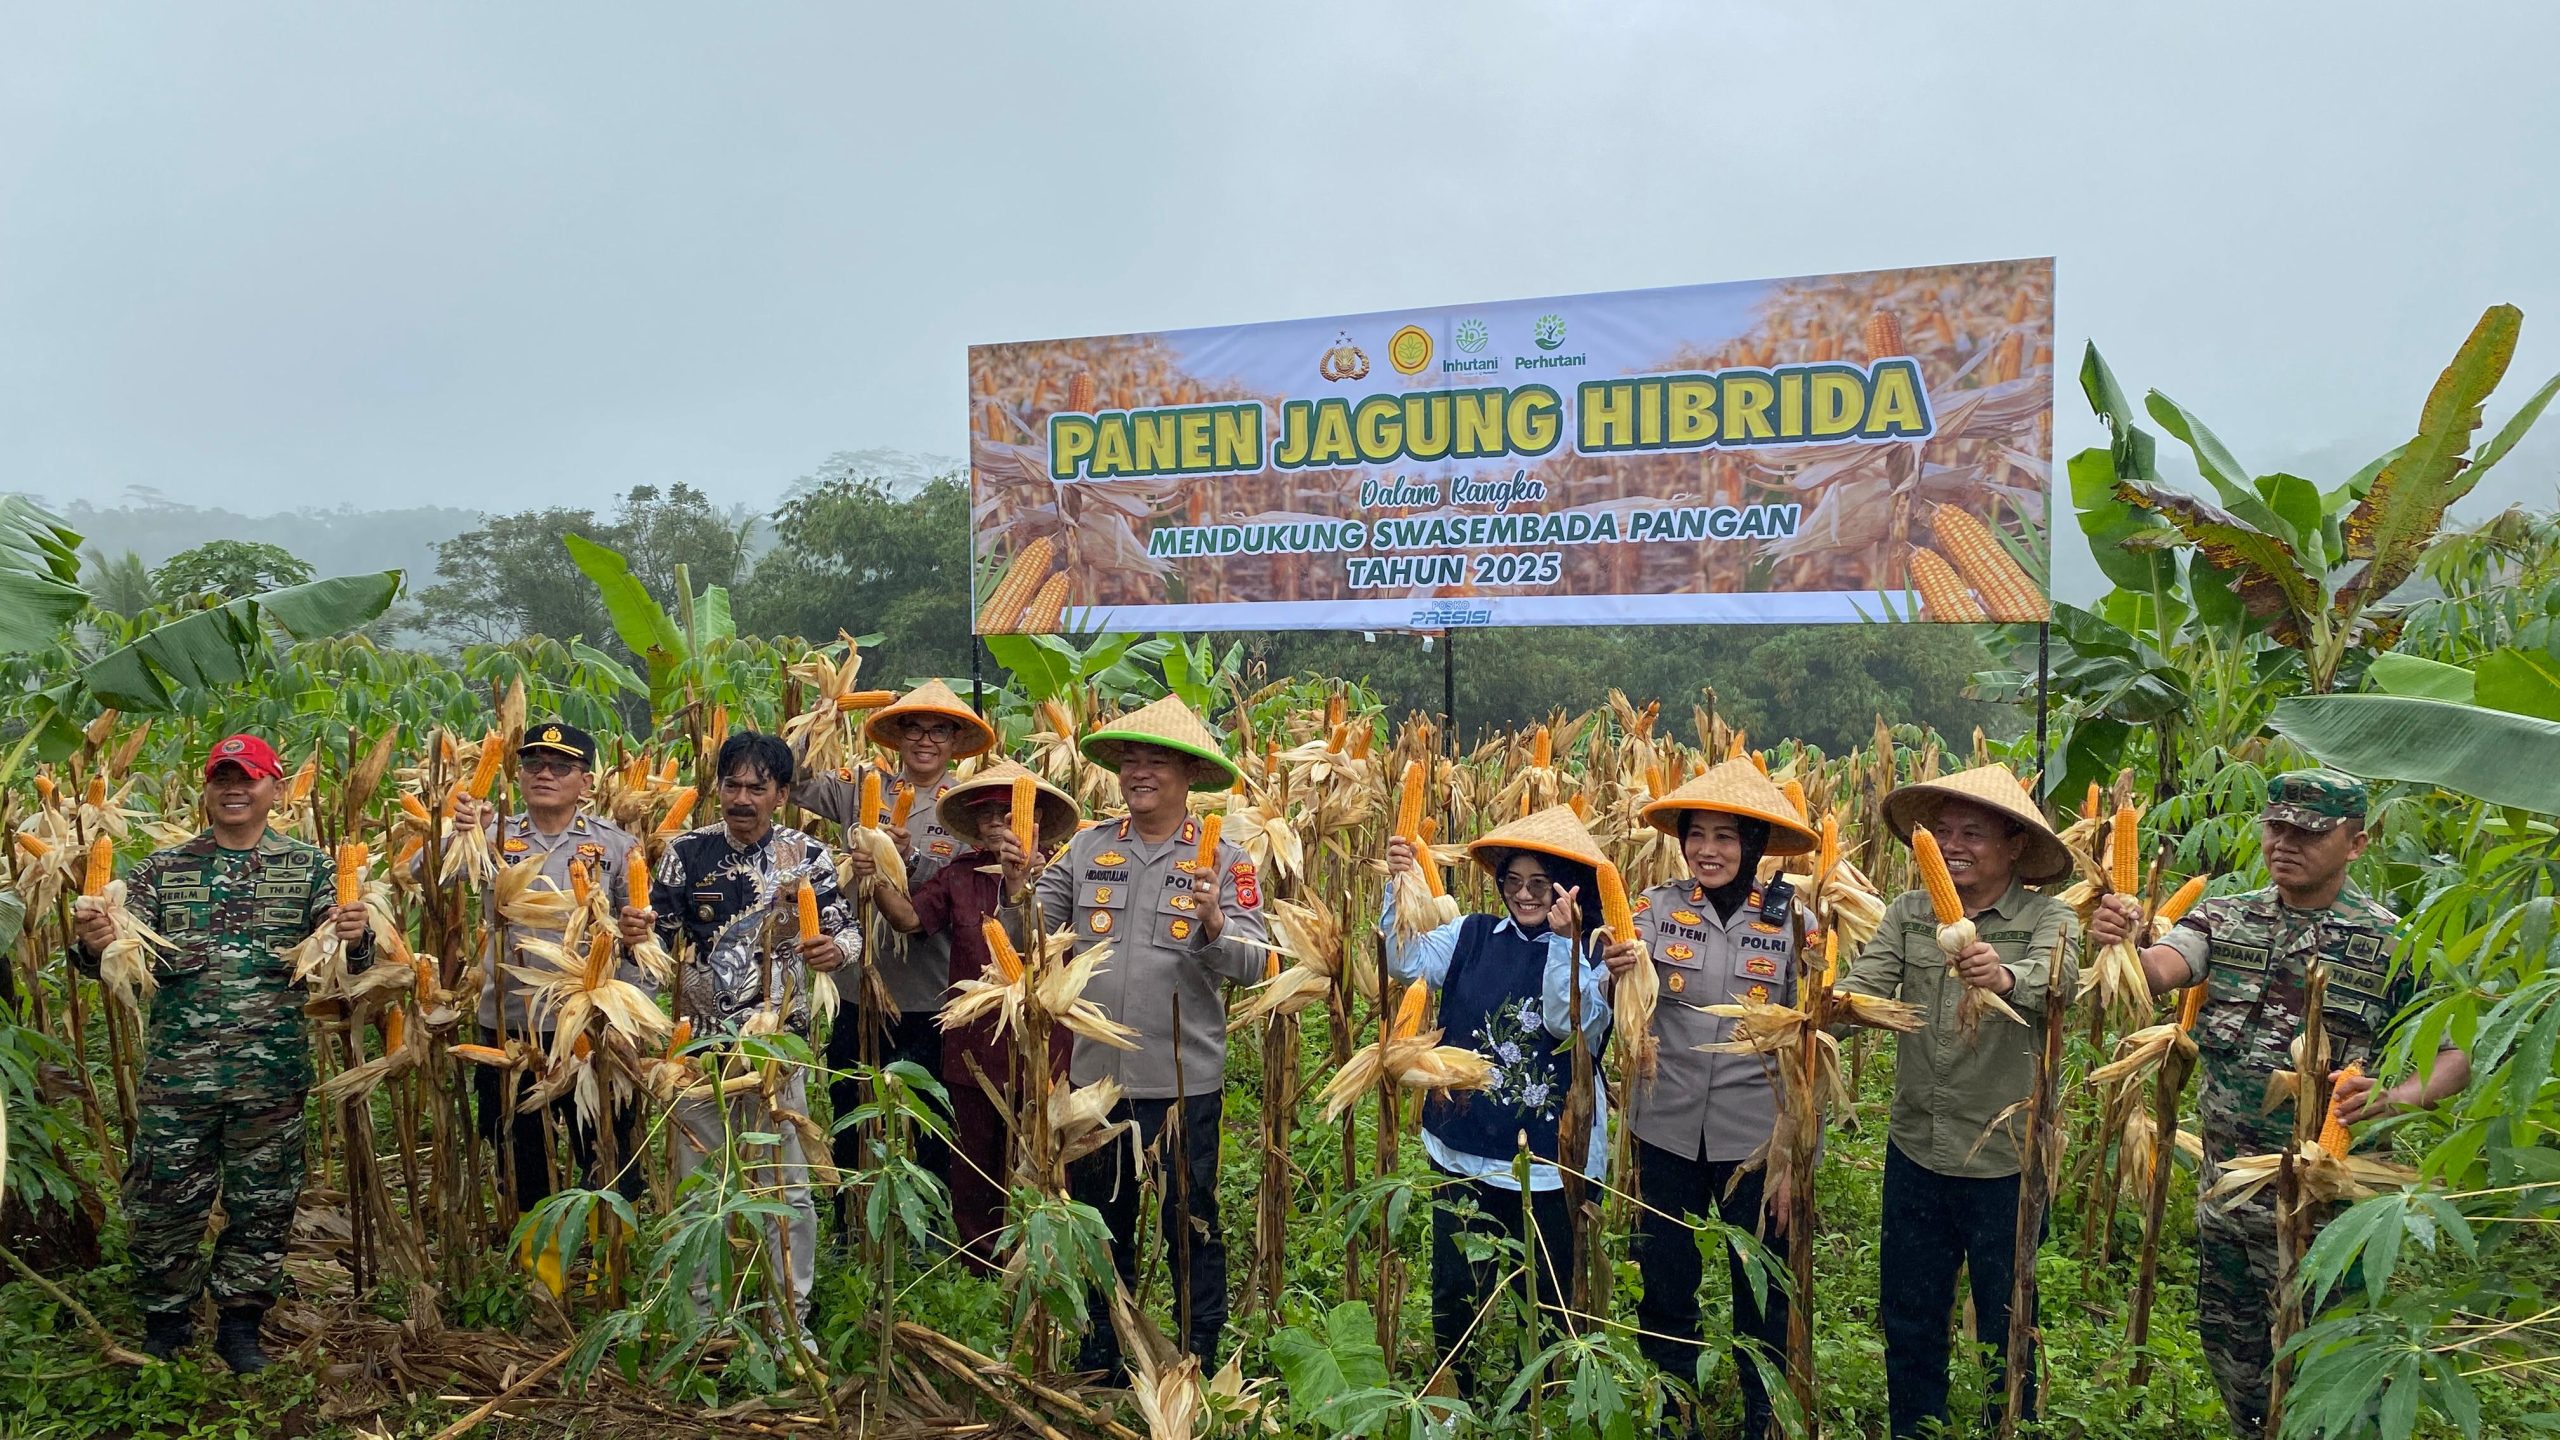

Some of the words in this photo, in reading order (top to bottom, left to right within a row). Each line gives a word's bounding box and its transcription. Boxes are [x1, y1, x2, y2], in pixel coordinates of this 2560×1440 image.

[1443, 357, 1498, 372] Inhutani
[1515, 353, 1586, 369] Perhutani
[1051, 402, 1263, 480] PANEN
[1274, 385, 1562, 471] JAGUNG
[1577, 361, 1934, 454] HIBRIDA
[1361, 475, 1439, 507] Dalam
[1452, 469, 1546, 512] Rangka
[1150, 521, 1364, 556] MENDUKUNG
[1373, 513, 1618, 549] SWASEMBADA
[1628, 506, 1798, 541] PANGAN
[1349, 557, 1464, 586] TAHUN
[1475, 555, 1560, 585] 2025
[1431, 600, 1470, 610] POSKO
[1410, 610, 1492, 625] PRESISI
[1085, 868, 1129, 883] HIDAYATULLAH
[1165, 874, 1193, 891] POL
[269, 886, 284, 895] TNI
[288, 886, 302, 895] AD
[1679, 926, 1707, 943] YENI
[1741, 936, 1787, 953] POLRI
[2332, 968, 2354, 984] TNI
[2354, 974, 2374, 989] AD
